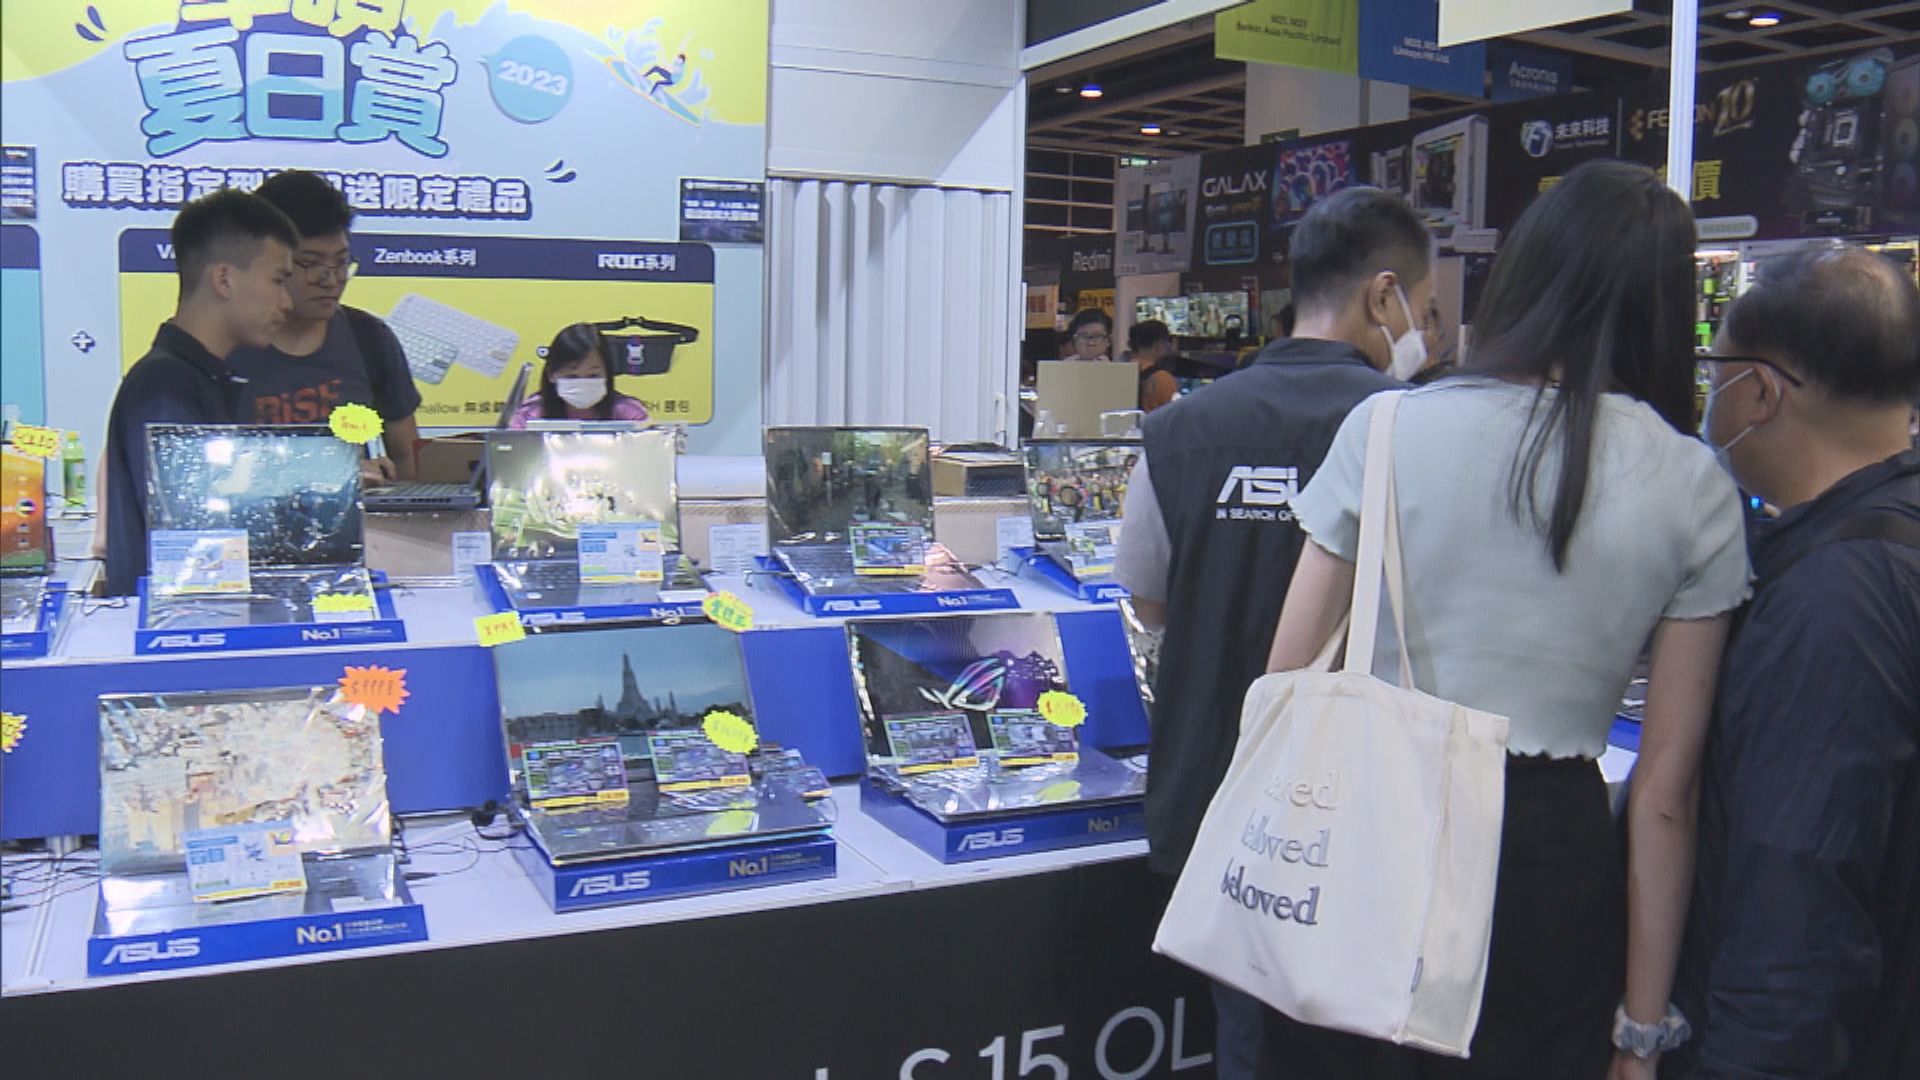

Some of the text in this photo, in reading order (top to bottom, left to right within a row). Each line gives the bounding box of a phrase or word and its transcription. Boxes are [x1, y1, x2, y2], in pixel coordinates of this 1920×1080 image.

[498, 59, 569, 96] 2023
[124, 26, 457, 158] 夏日賞
[1202, 170, 1267, 198] GALAX
[1073, 248, 1112, 271] Redmi
[1229, 507, 1276, 521] SEARCH
[822, 600, 883, 612] ASUS
[147, 633, 227, 649] ASUS
[301, 629, 342, 642] No.1
[956, 827, 1026, 852] ASUS
[728, 856, 769, 878] No.1
[568, 870, 651, 898] ASUS
[296, 922, 345, 945] No.1
[102, 937, 200, 966] ASUS
[978, 1024, 1069, 1080] 15
